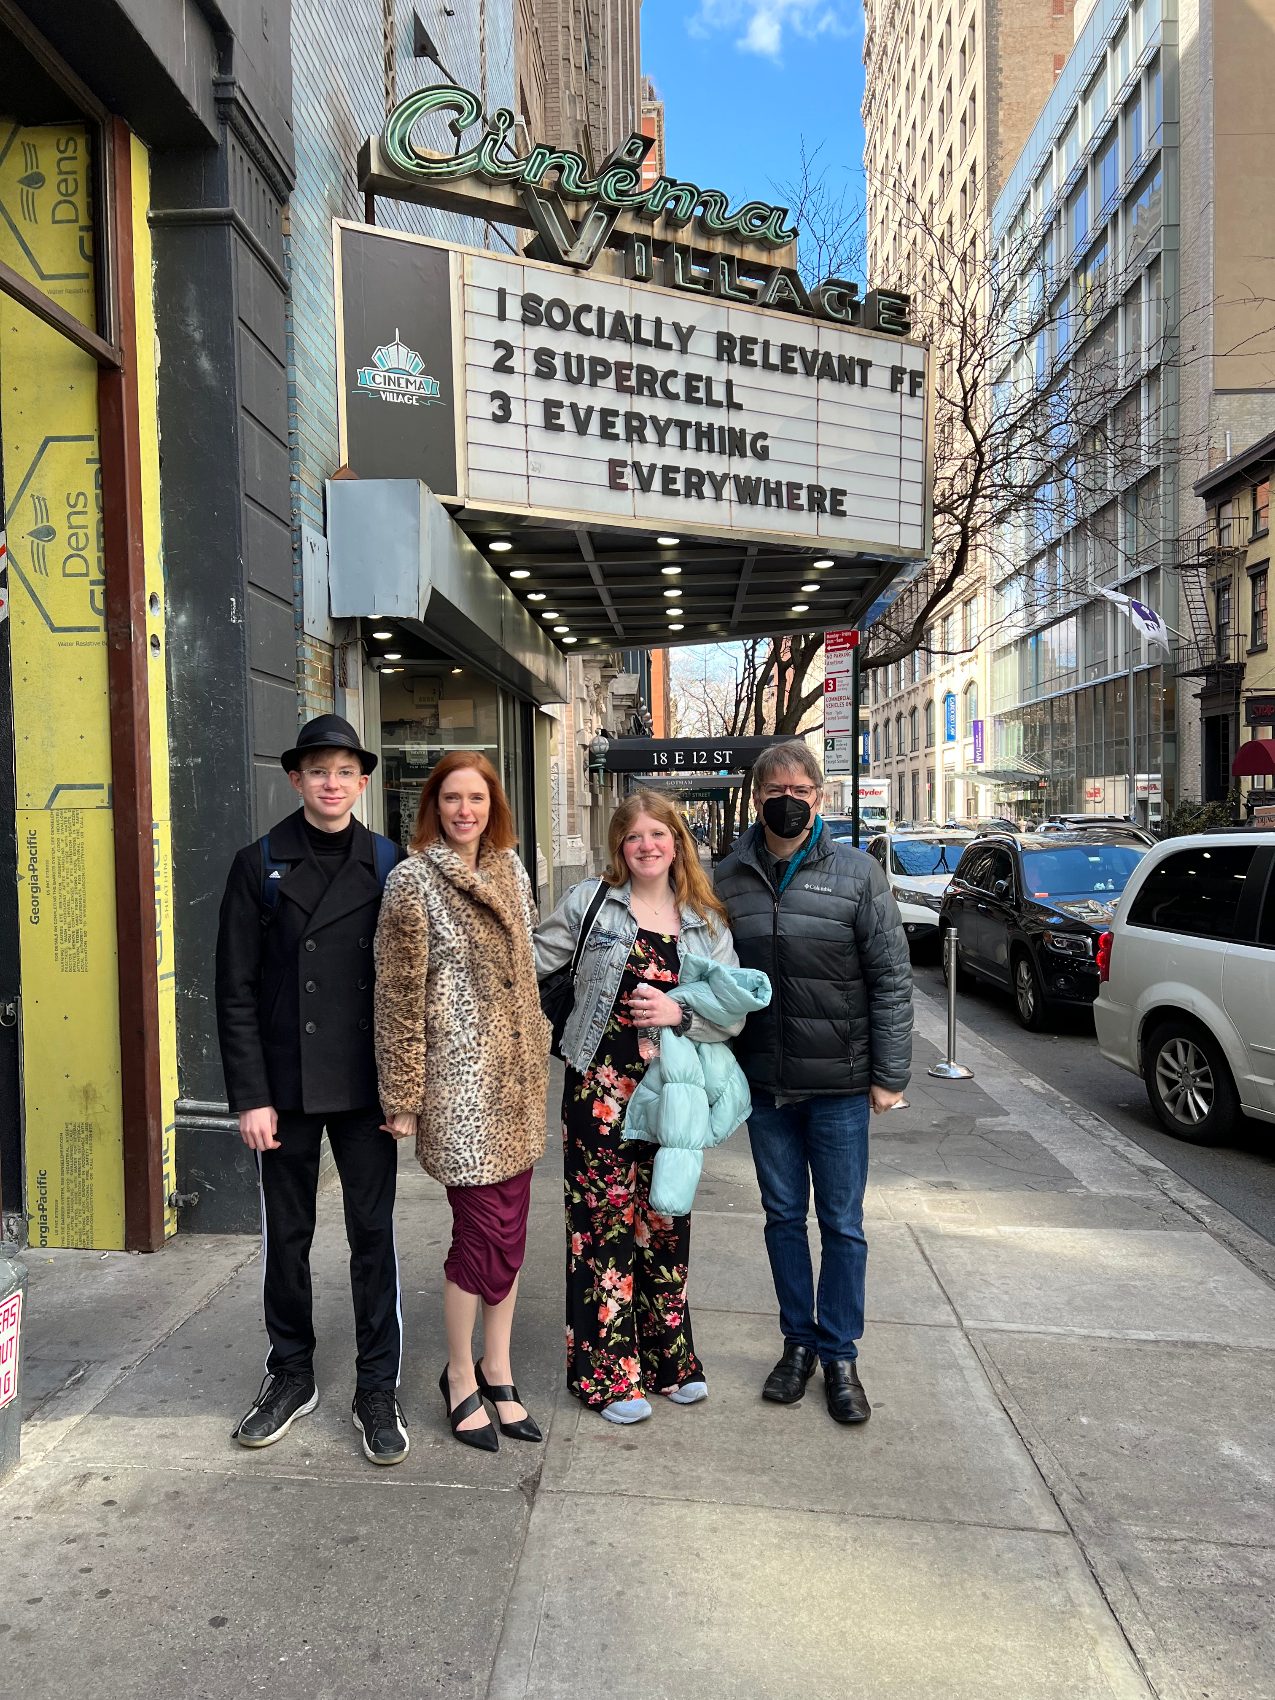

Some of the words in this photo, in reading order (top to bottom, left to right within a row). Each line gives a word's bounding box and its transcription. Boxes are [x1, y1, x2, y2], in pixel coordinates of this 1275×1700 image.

[51, 136, 80, 225] Dens
[524, 186, 912, 336] VILLAGE
[521, 291, 696, 355] SOCIALLY
[717, 330, 873, 388] RELEVANT
[891, 366, 925, 398] FF
[371, 372, 428, 393] CINEMA
[379, 391, 420, 406] VILLAGE
[493, 340, 515, 375] 2
[534, 347, 744, 411] SUPERCELL
[491, 390, 513, 424] 3
[544, 399, 770, 462] EVERYTHING
[609, 458, 848, 518] EVERYWHERE
[62, 491, 90, 578] Dens
[828, 680, 834, 691] 3
[652, 752, 668, 766] 18
[674, 752, 684, 765] E
[692, 751, 708, 764] 12
[714, 750, 733, 764] ST
[826, 740, 832, 750] 2
[858, 788, 884, 797] Ryder
[28, 829, 42, 925] Georgia-Pacific
[810, 884, 832, 893] Columbia
